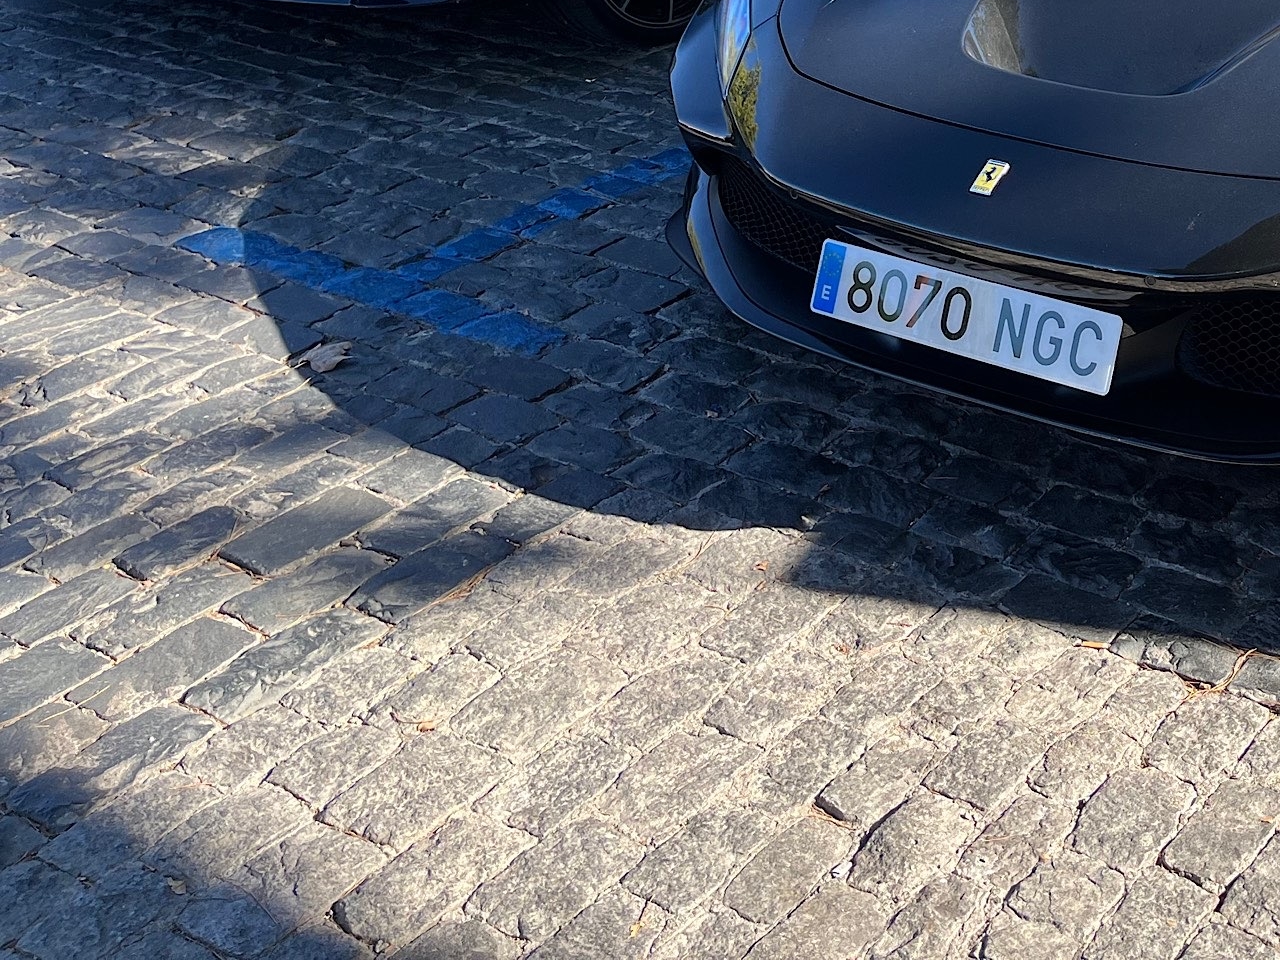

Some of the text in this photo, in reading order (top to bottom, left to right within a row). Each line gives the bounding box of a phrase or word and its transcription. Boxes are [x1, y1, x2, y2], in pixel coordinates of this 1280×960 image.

[820, 285, 831, 300] E
[847, 260, 1103, 377] 8070 NGC
